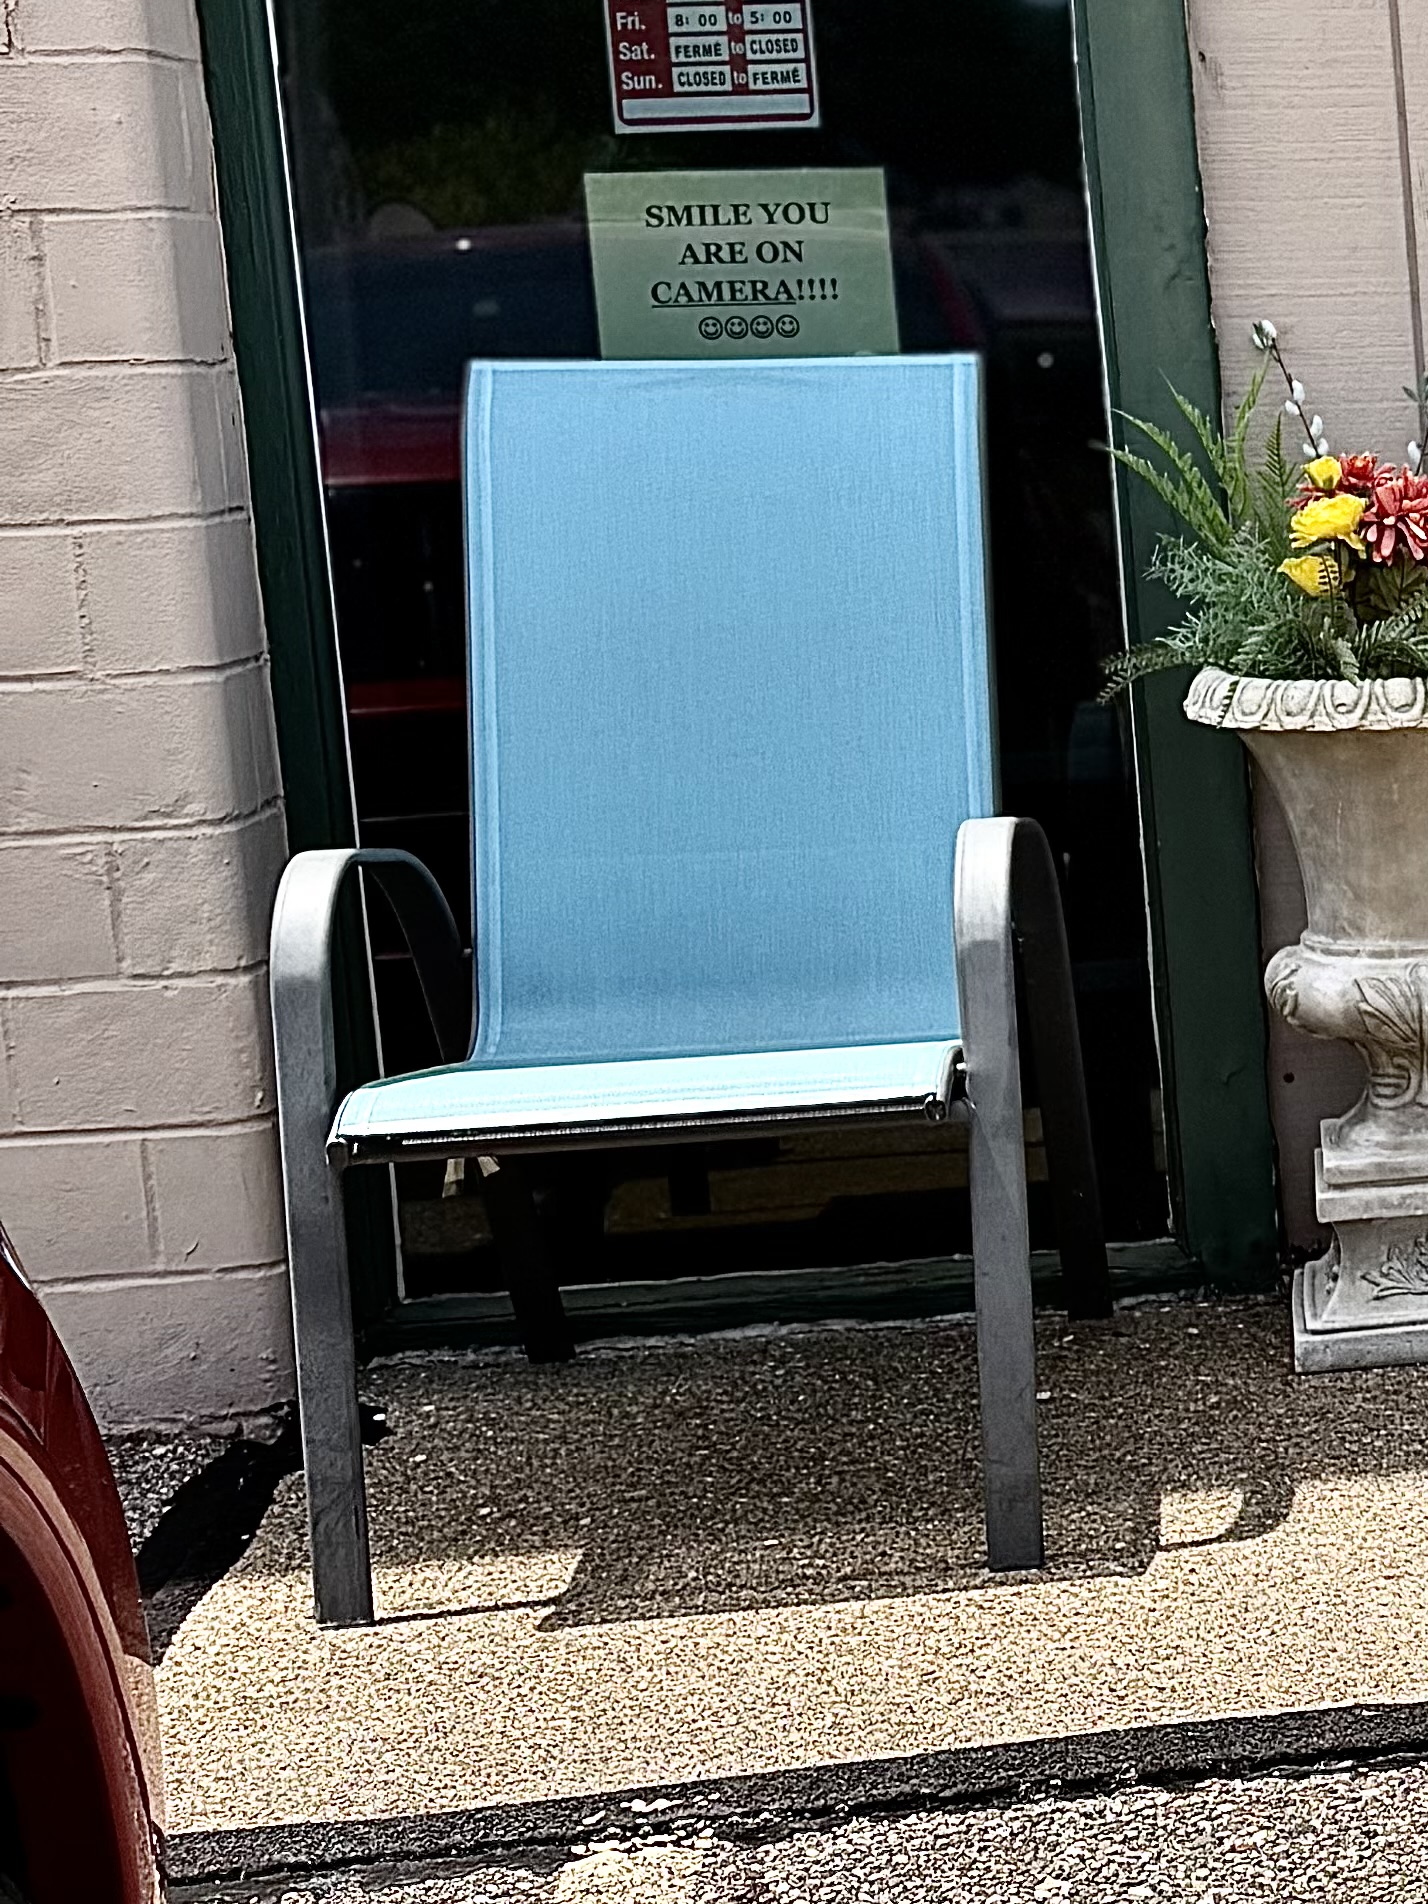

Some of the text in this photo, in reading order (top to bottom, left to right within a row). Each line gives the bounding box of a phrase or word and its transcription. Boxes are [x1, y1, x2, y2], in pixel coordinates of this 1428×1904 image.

[616, 12, 645, 31] Fri.
[728, 11, 742, 24] to
[619, 38, 798, 60] Sat. FERMÉ to CLOSED
[621, 67, 801, 90] Sun. CLOSED to FERMÉ
[645, 202, 831, 228] SMILE YOU
[679, 240, 804, 265] ARE ON
[651, 278, 839, 304] CAMERA!!!!
